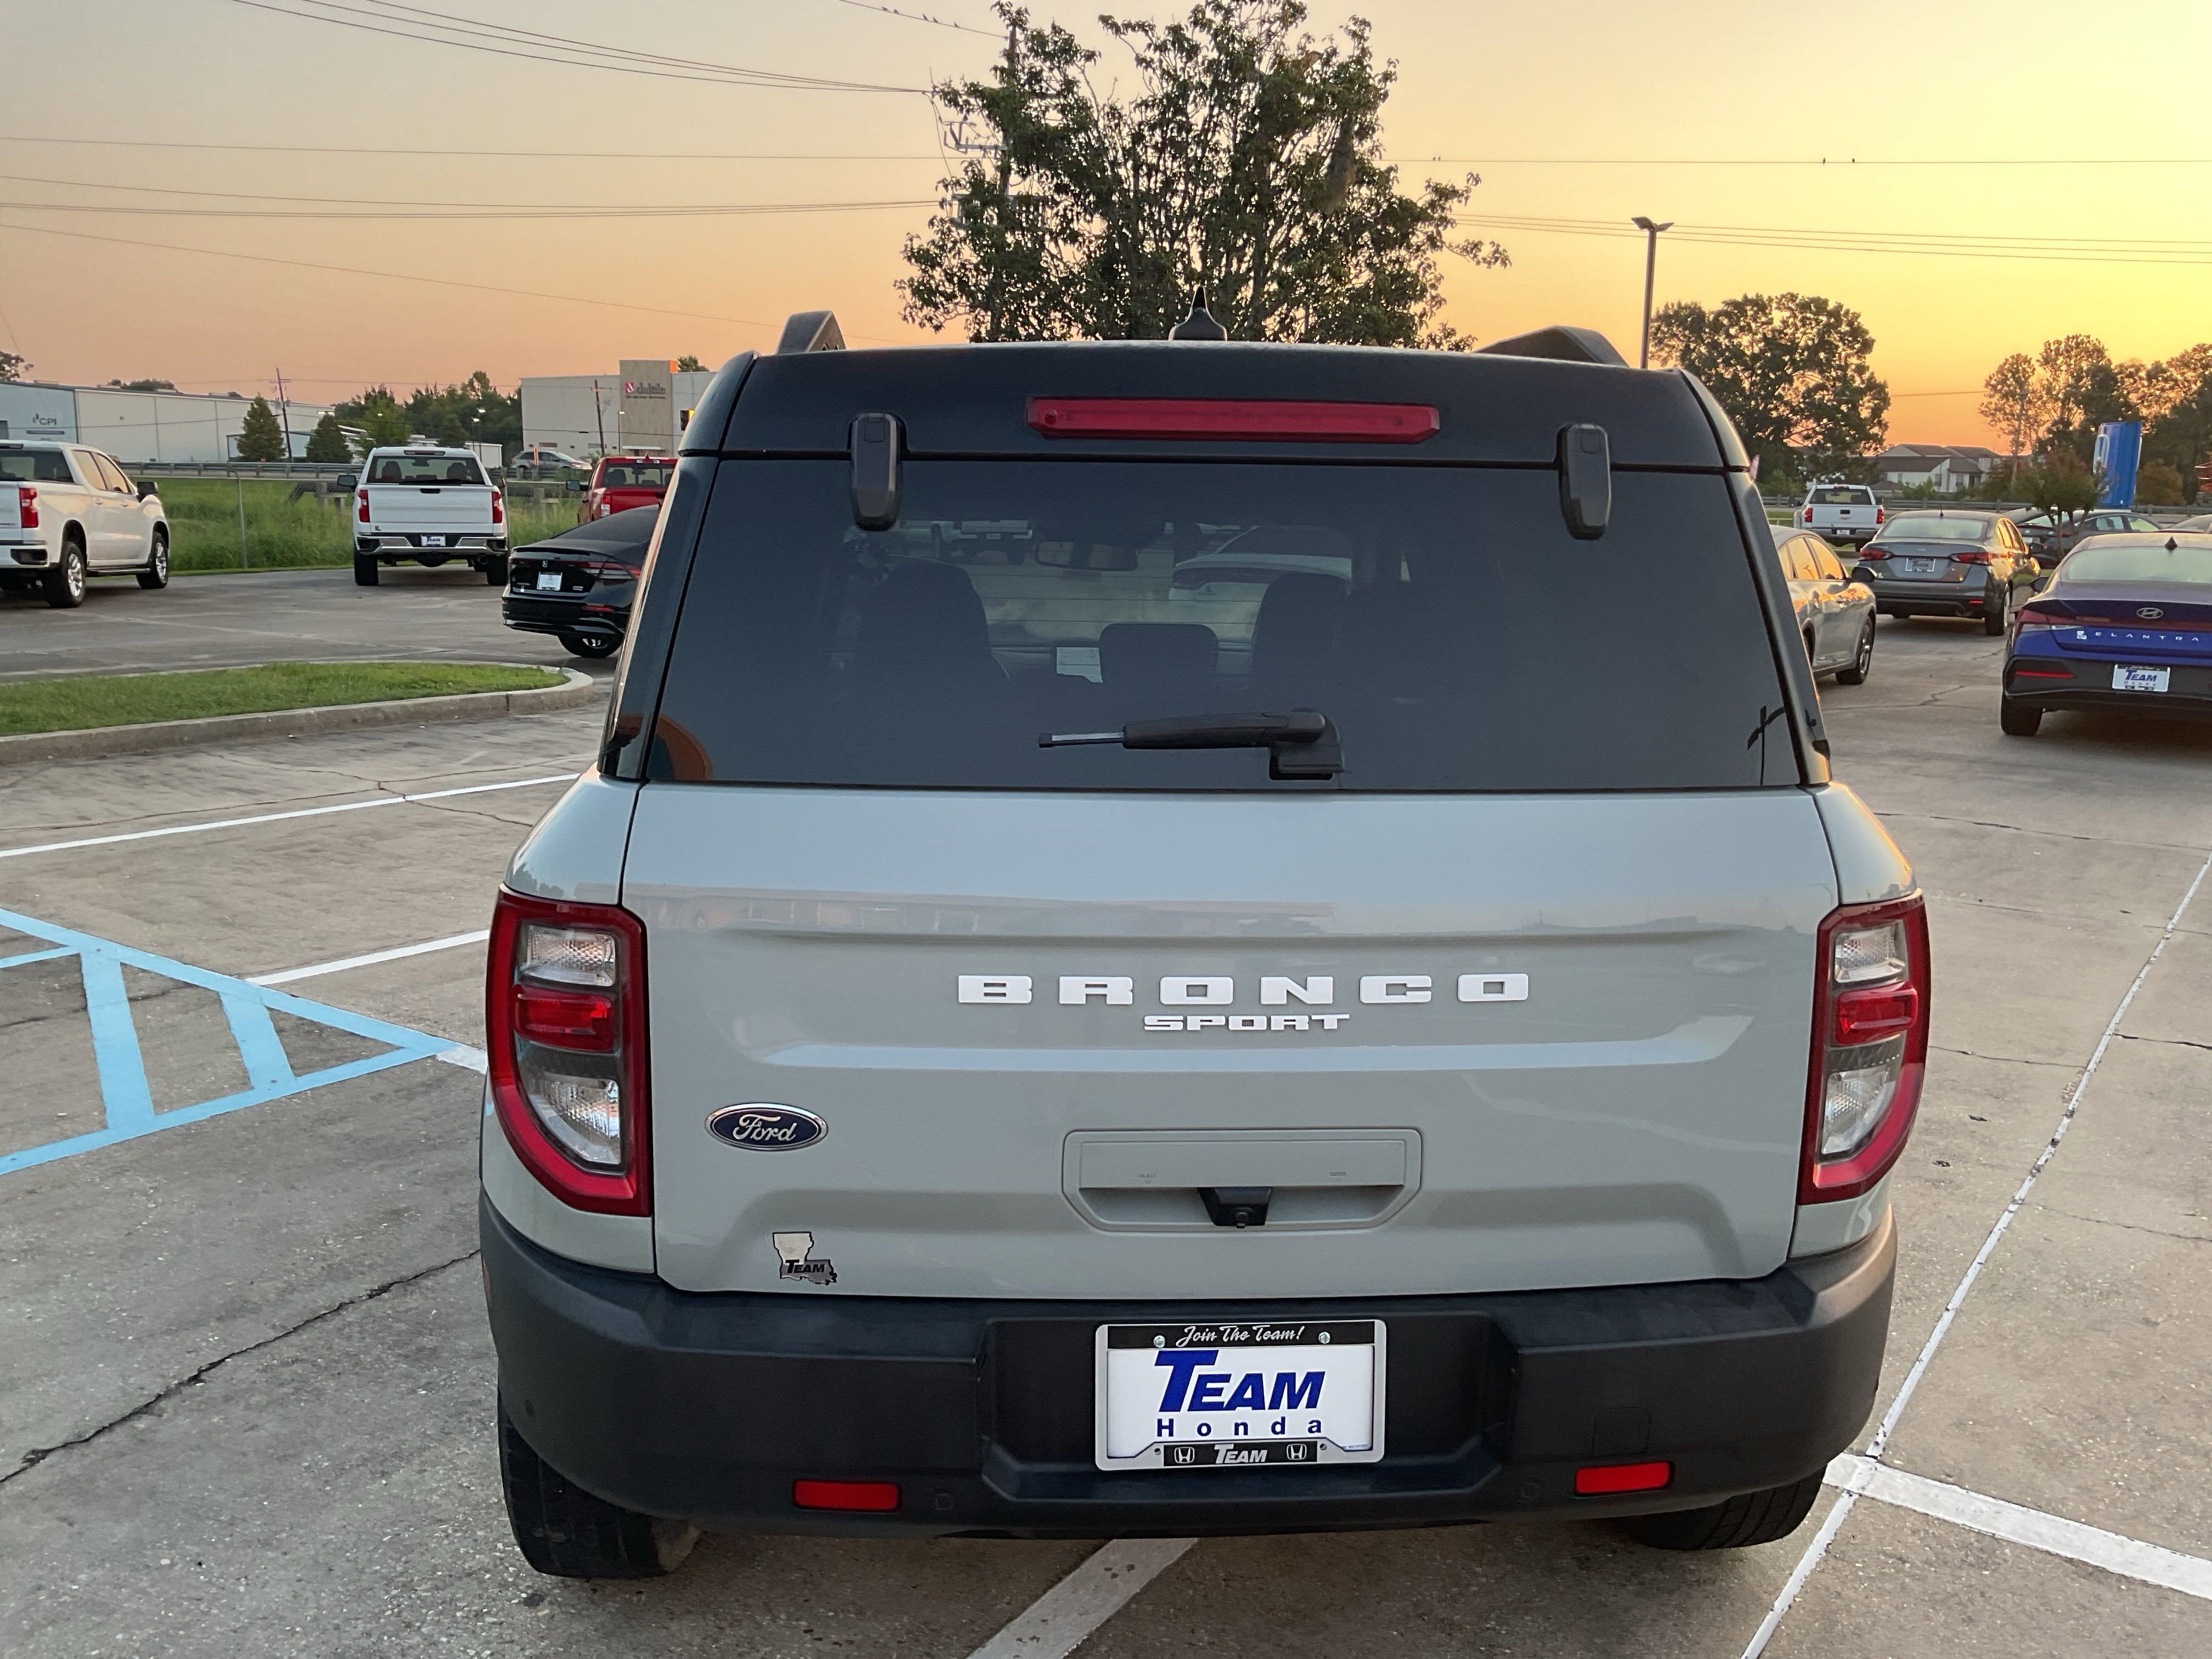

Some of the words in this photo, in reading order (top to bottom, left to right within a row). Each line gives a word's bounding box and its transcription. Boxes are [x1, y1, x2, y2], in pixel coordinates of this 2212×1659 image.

[39, 417, 57, 426] CPI
[2095, 631, 2199, 641] ELANTRA
[2125, 668, 2157, 681] TEAM
[957, 973, 1529, 1005] BRONCO
[1143, 1013, 1350, 1031] SPORT
[733, 1114, 797, 1141] Ford
[785, 1260, 825, 1273] TEAM
[1176, 1325, 1217, 1347] Join
[1220, 1325, 1250, 1342] The
[1252, 1325, 1305, 1341] Team!
[1154, 1350, 1325, 1412] TEAM
[1157, 1417, 1322, 1437] Honda
[1214, 1443, 1268, 1464] TEAM
